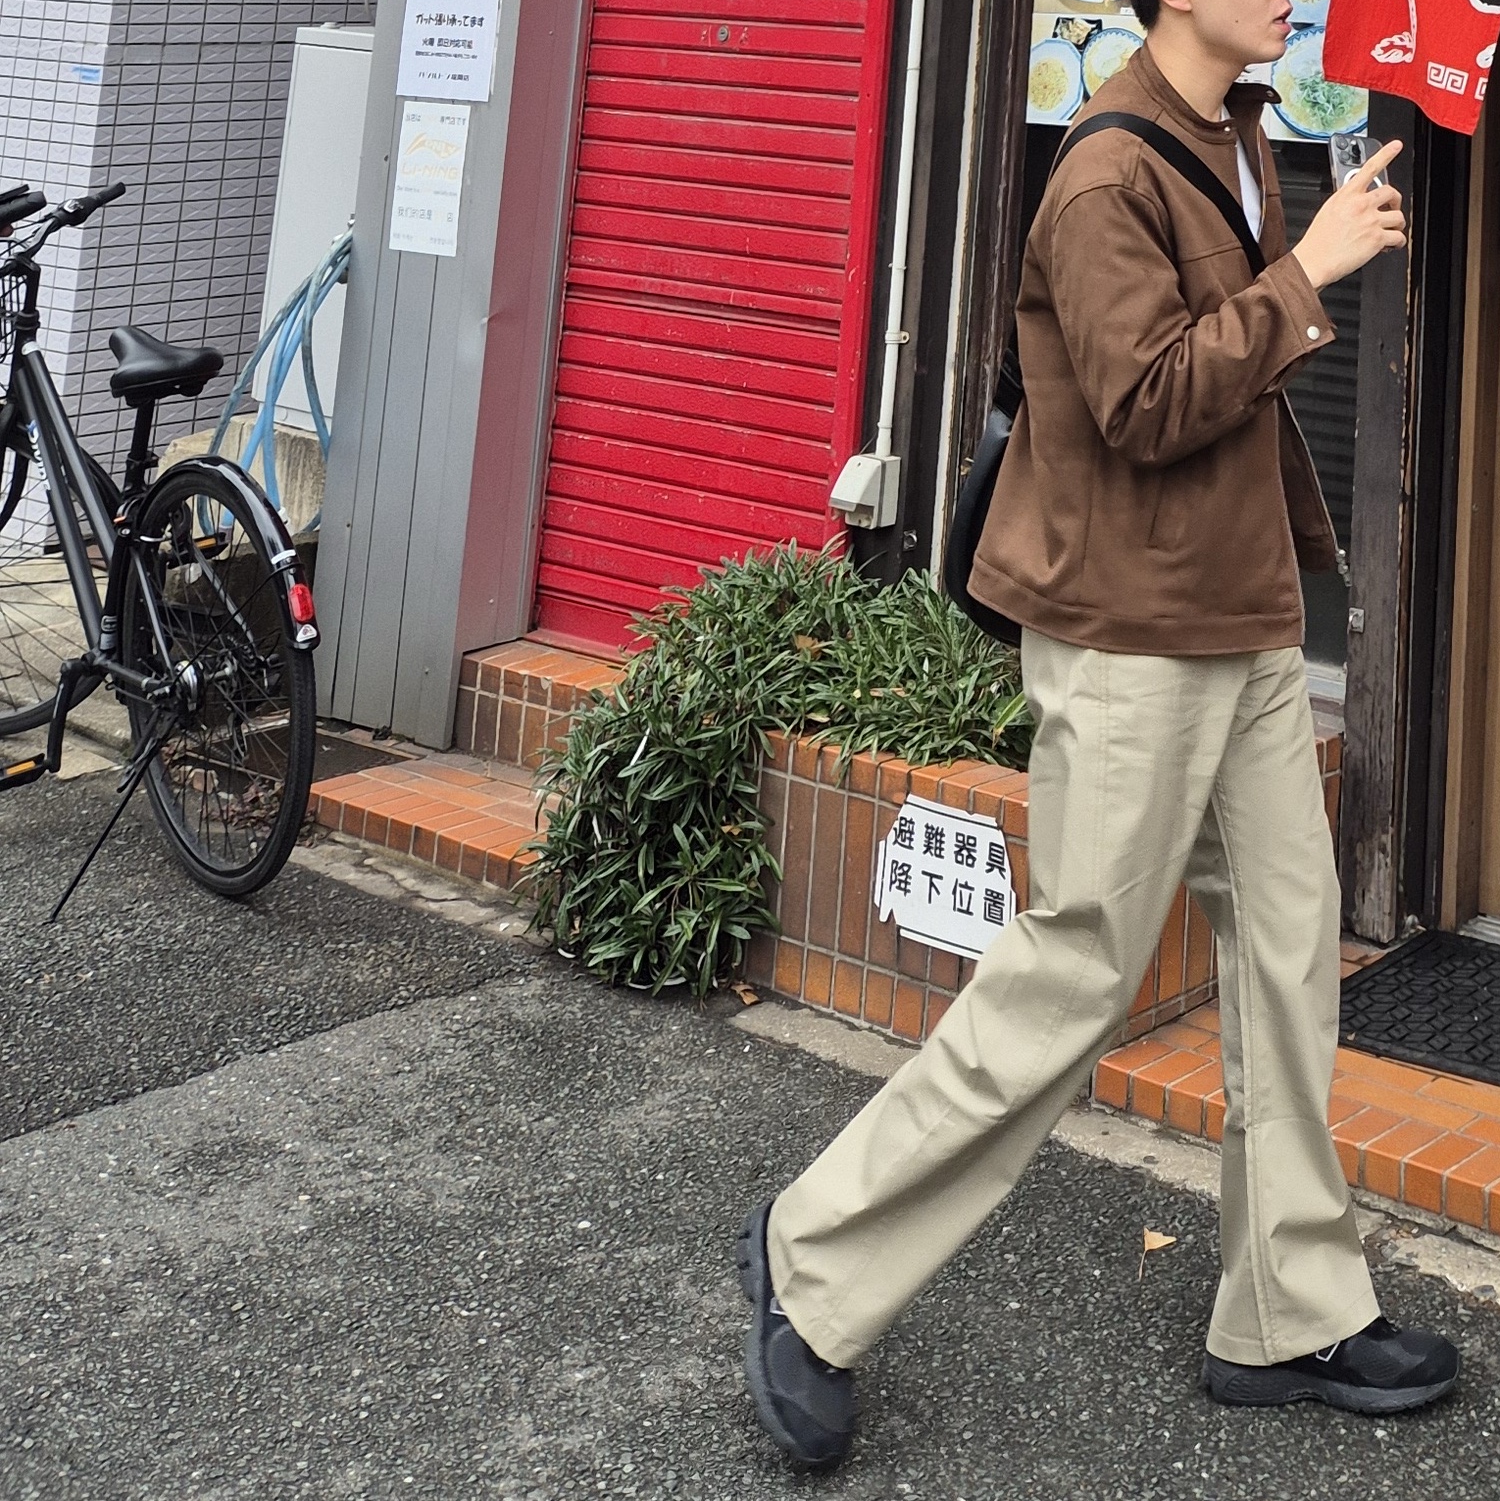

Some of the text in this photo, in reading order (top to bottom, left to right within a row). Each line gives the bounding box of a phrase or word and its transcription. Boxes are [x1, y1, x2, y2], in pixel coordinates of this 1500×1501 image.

[891, 815, 1007, 881] 避難器具
[888, 859, 1006, 927] 降下位置
